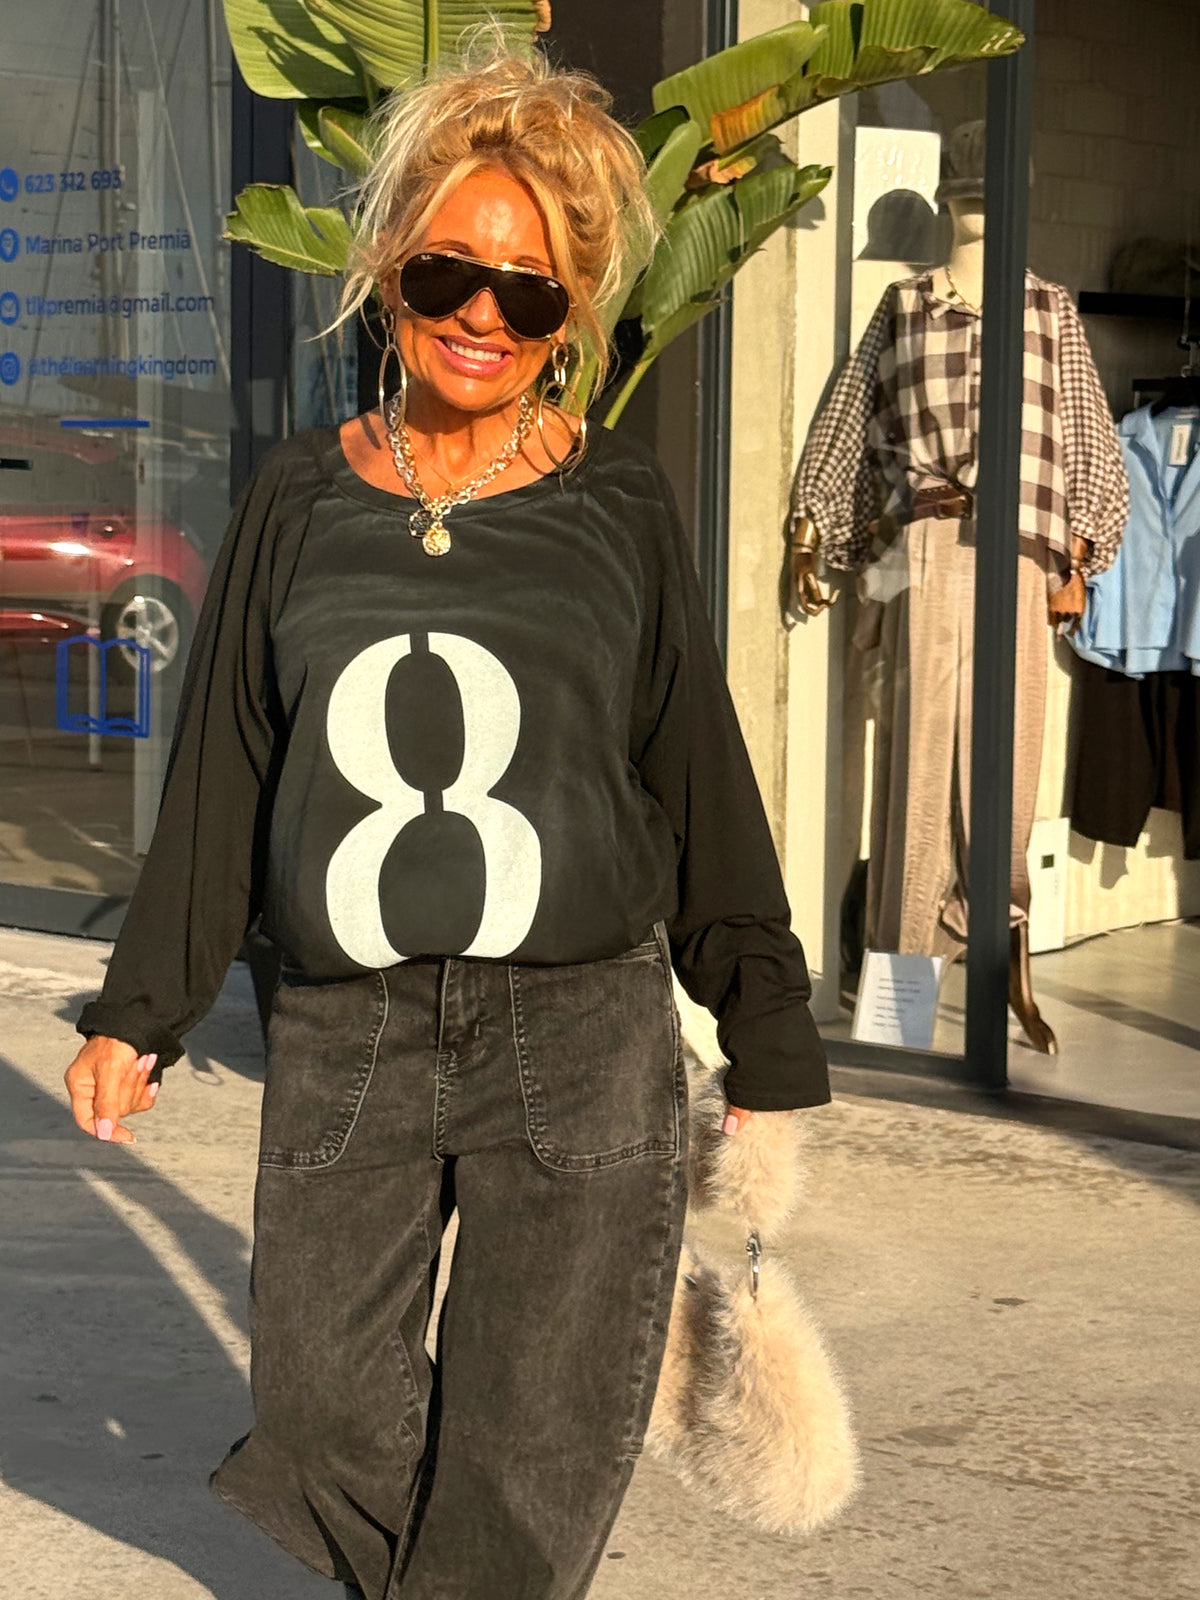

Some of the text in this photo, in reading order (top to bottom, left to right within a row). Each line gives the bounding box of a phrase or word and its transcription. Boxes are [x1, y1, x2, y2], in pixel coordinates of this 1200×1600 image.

[25, 169, 122, 193] 623 312 693
[25, 234, 83, 255] Marina
[88, 232, 124, 252] Port
[326, 631, 542, 969] 8
